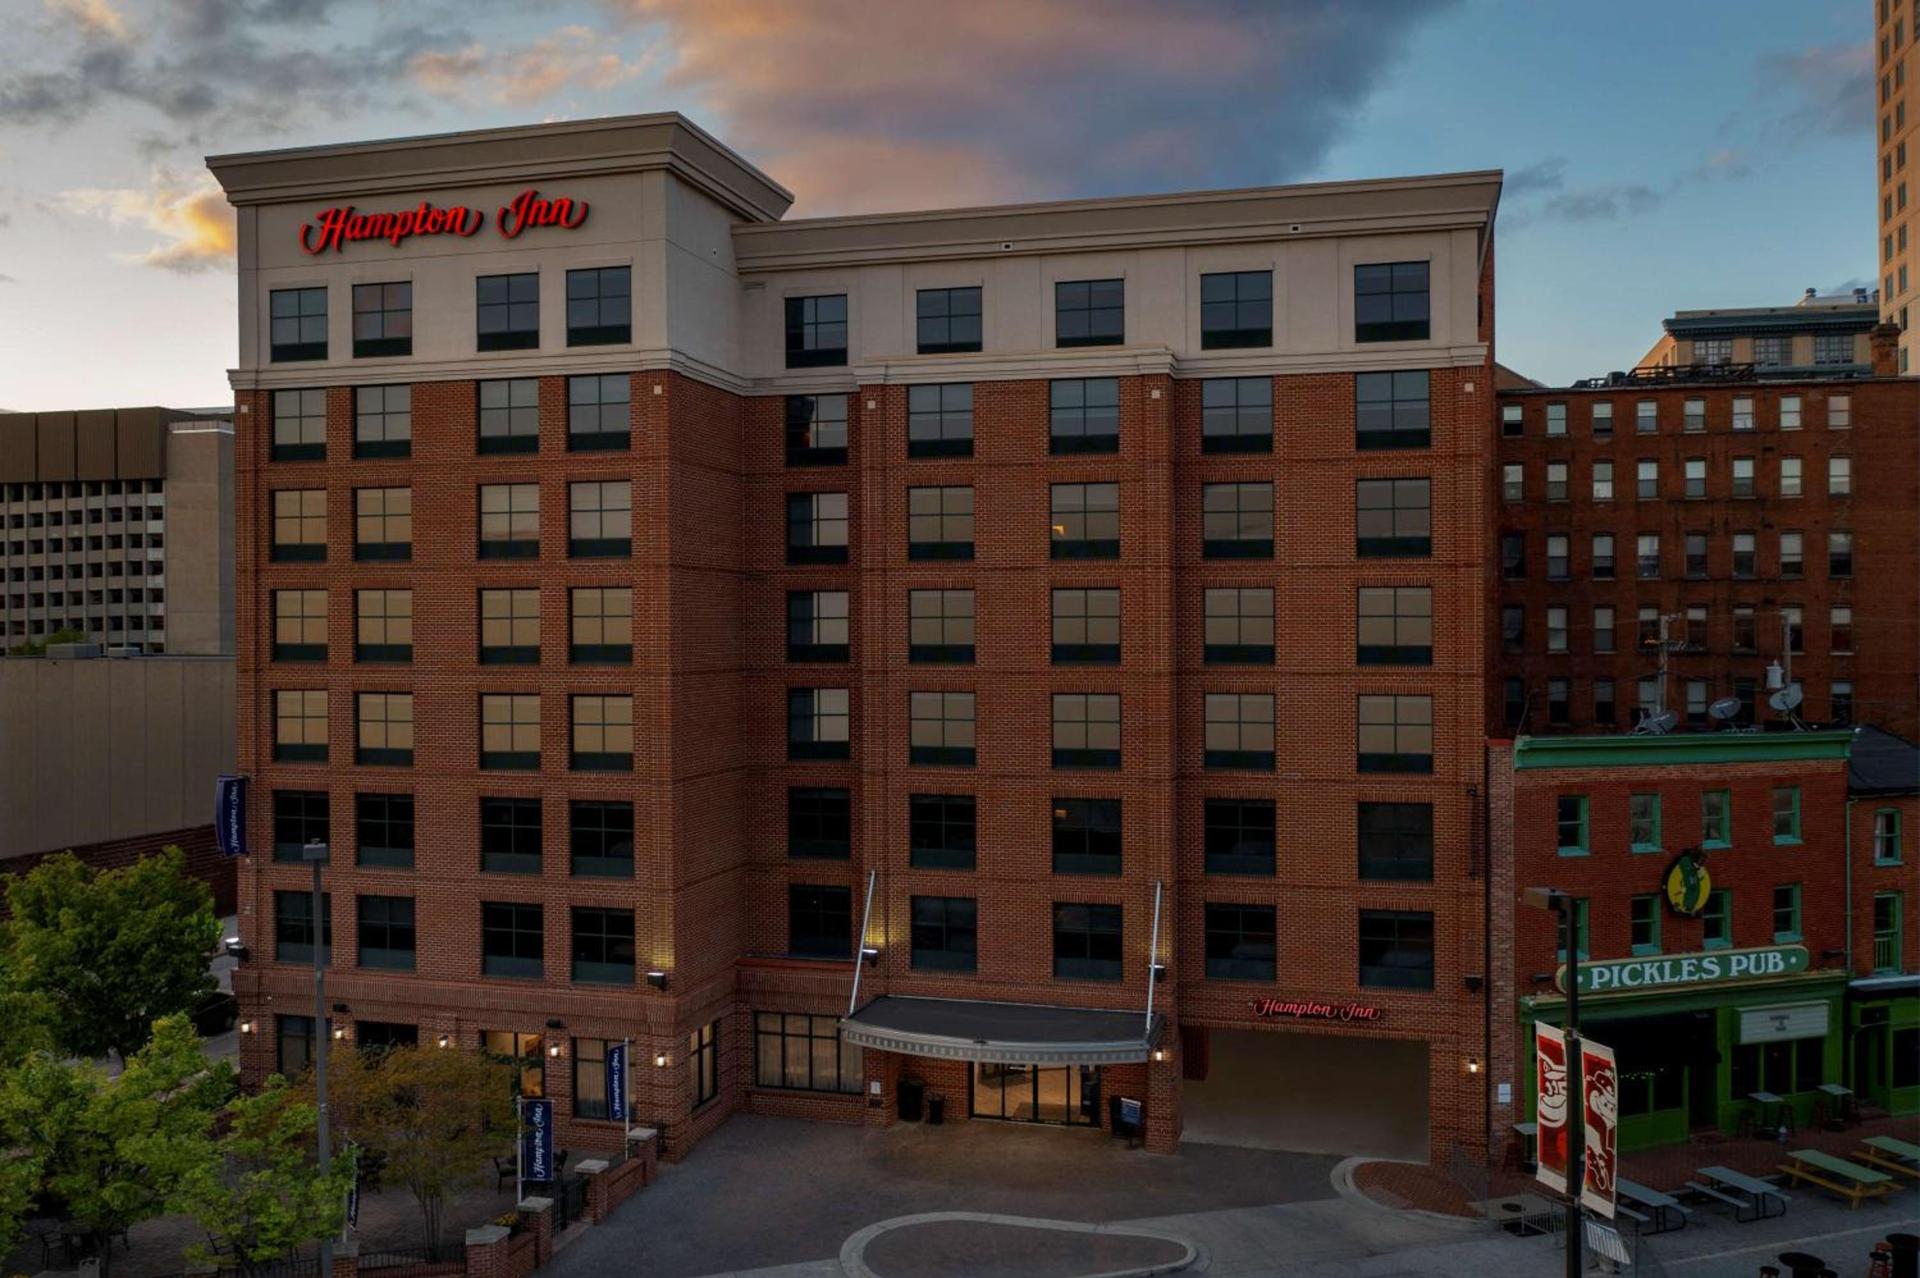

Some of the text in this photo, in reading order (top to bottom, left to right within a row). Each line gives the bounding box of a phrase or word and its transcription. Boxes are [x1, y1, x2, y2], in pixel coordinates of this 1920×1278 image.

[300, 189, 590, 256] Hampton Inn
[229, 805, 241, 852] Hampton
[1590, 951, 1785, 990] PICKLES PUB
[1253, 999, 1381, 1021] Hampton Inn
[612, 1071, 622, 1119] Hampton
[532, 1102, 546, 1178] Hampton Inn
